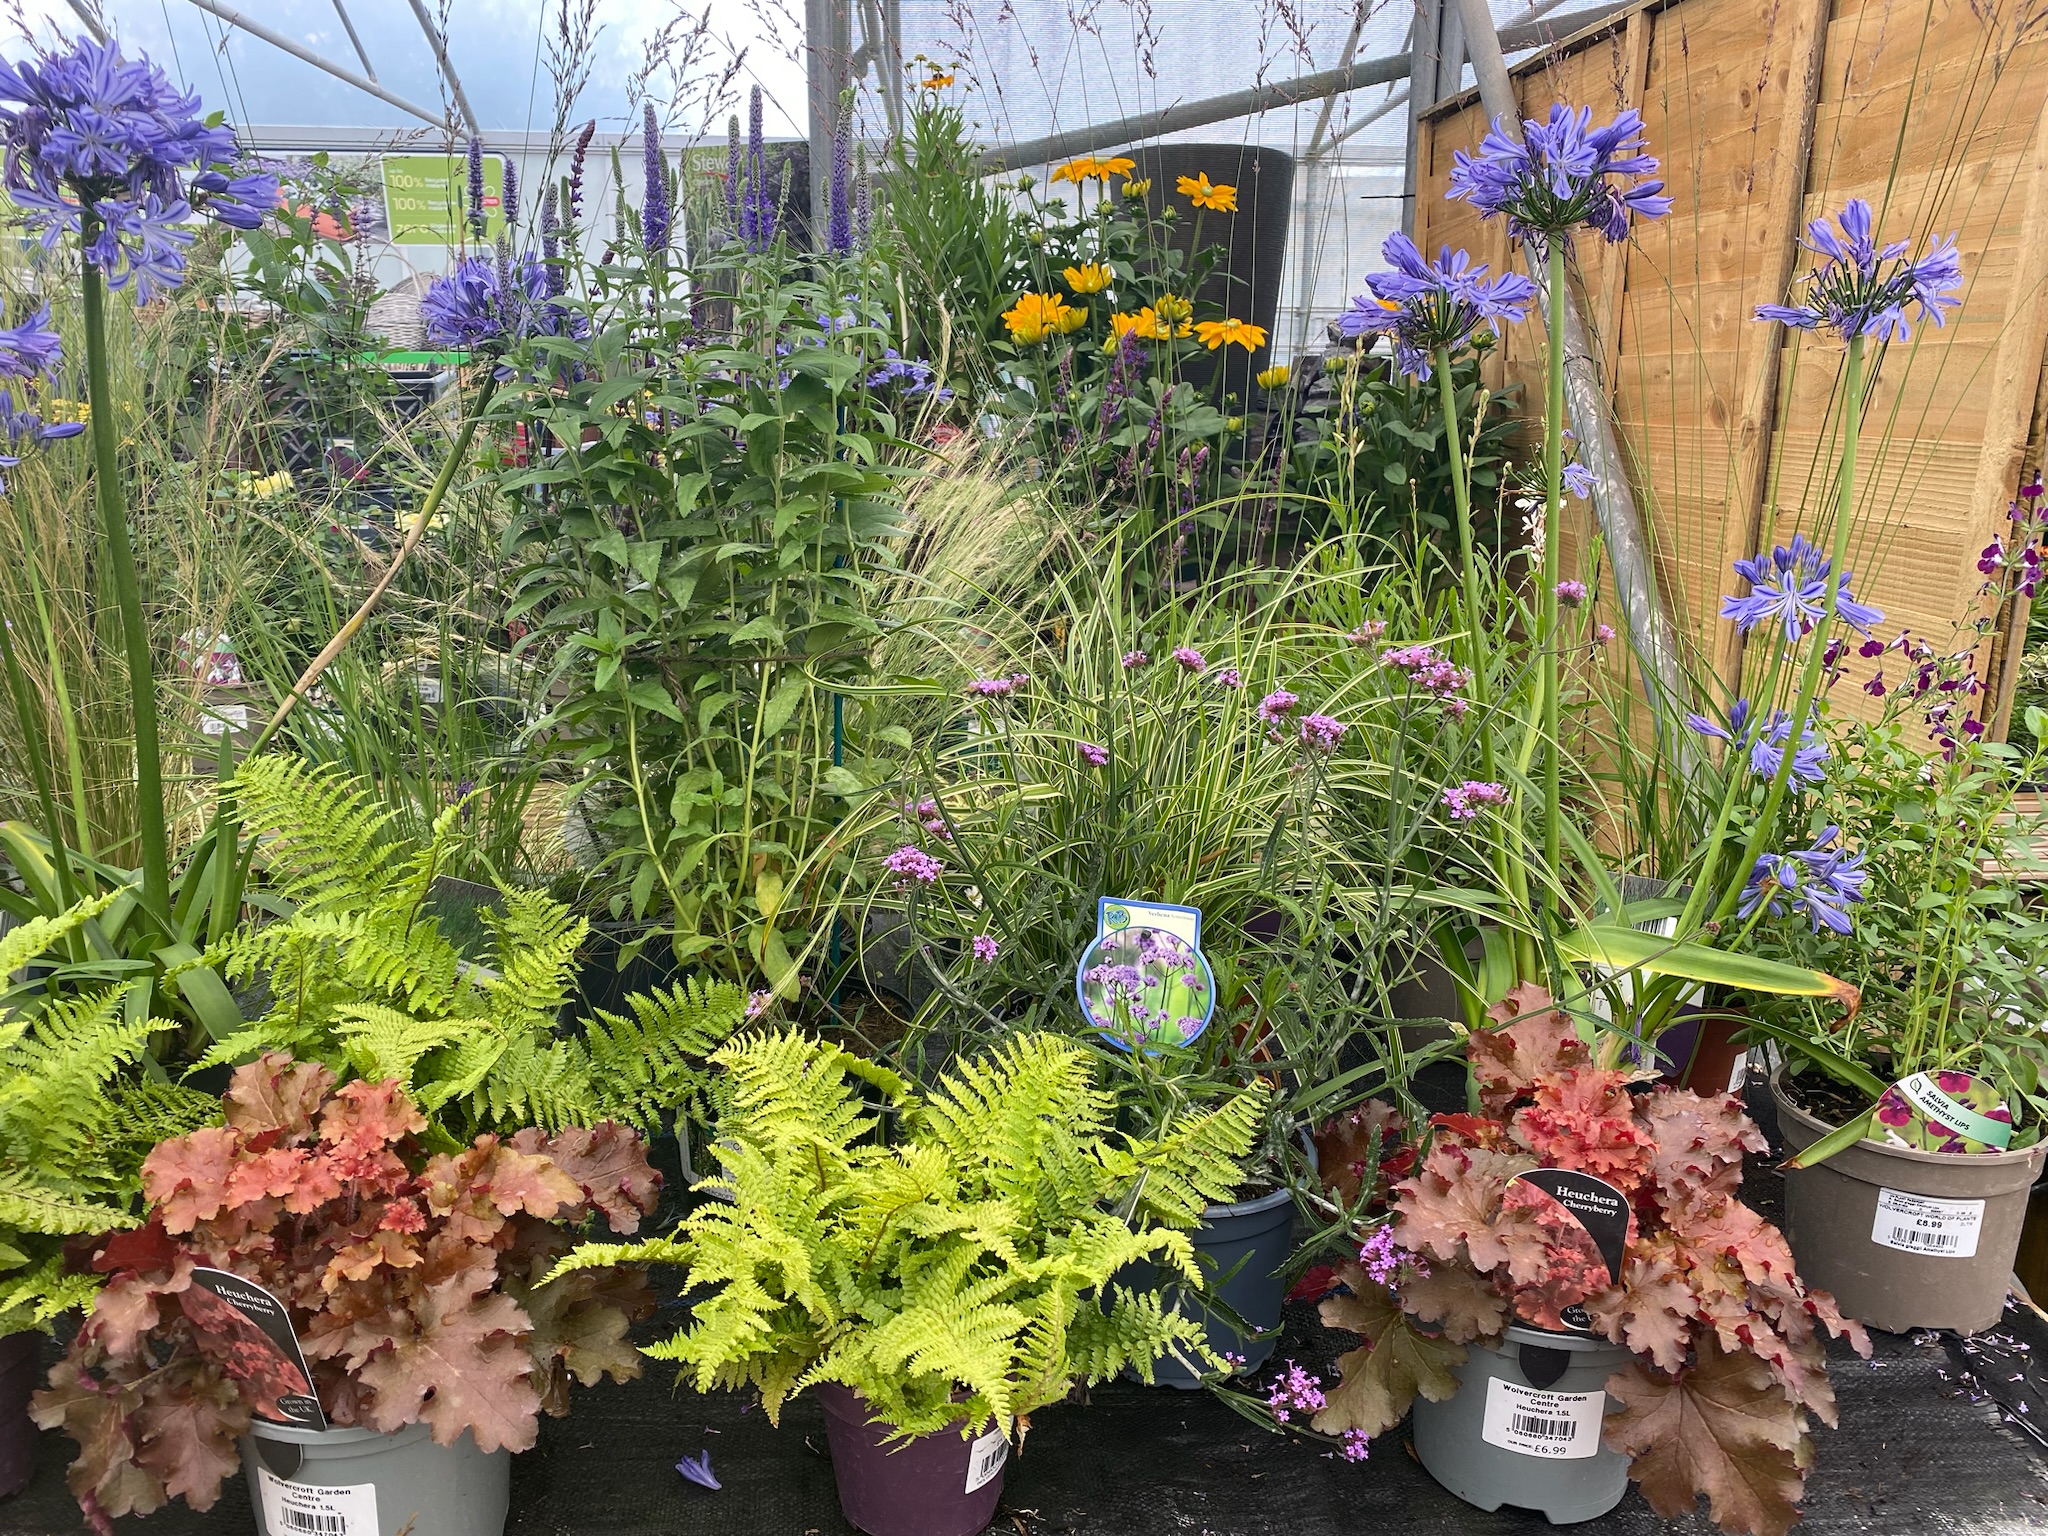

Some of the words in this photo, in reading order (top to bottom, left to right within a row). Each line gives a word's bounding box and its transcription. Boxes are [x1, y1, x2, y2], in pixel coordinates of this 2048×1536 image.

[389, 174, 424, 188] 100%
[392, 198, 426, 211] 100%
[1148, 910, 1170, 918] Verbena
[1926, 1090, 1950, 1110] SALVIA
[1920, 1096, 1955, 1122] AMETHYST
[1955, 1119, 1970, 1130] LIPS
[1556, 1186, 1618, 1206] Heuchera
[1563, 1200, 1617, 1217] Cherryberry
[1879, 1204, 1923, 1217] WOLVERCROFT
[215, 1284, 272, 1307] Heuchera
[226, 1298, 274, 1316] Cherryberry
[1503, 1384, 1554, 1400] Wolvercroft
[1516, 1404, 1553, 1415] Heuchera
[1530, 1399, 1559, 1408] Centre
[1534, 1445, 1566, 1455] £6.99
[267, 1475, 313, 1494] Wolvercroft
[281, 1497, 316, 1510] Heuchera
[292, 1492, 321, 1502] Centre
